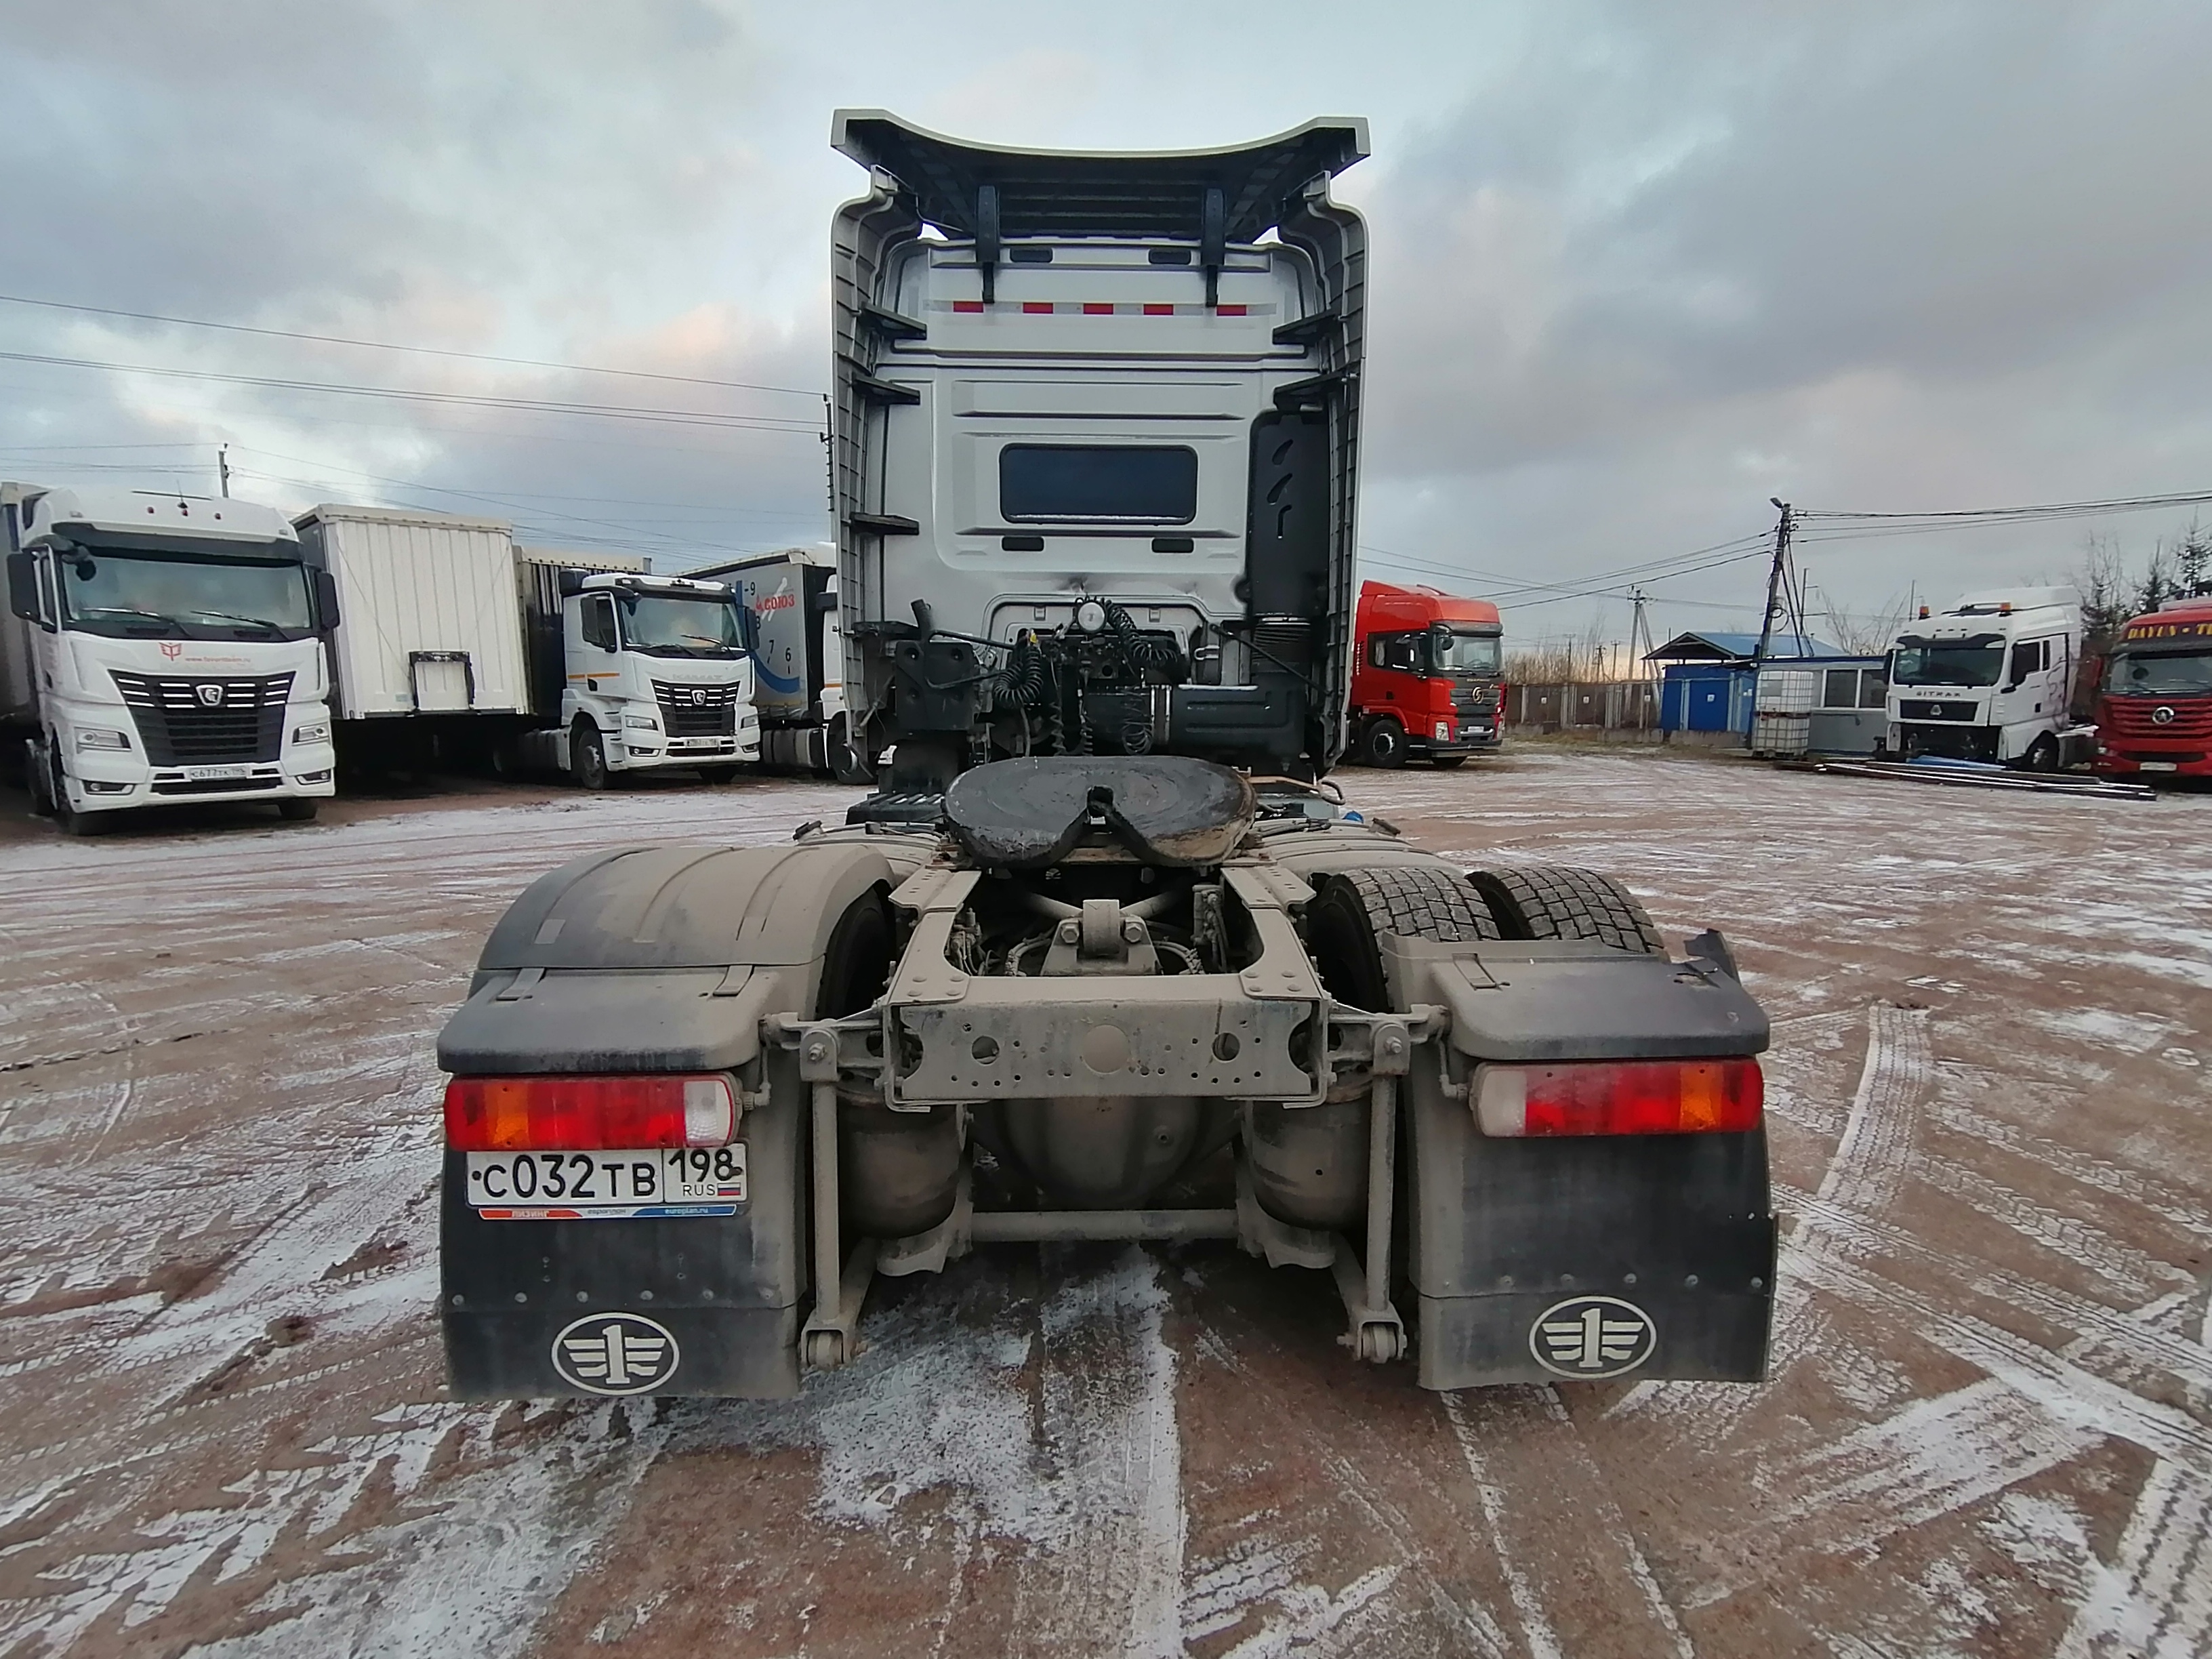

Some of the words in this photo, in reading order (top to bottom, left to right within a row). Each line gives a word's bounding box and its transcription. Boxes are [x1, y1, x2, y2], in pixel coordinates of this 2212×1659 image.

[483, 1154, 656, 1198] С032ТВ
[668, 1148, 735, 1183] 198
[682, 1183, 716, 1196] RUS
